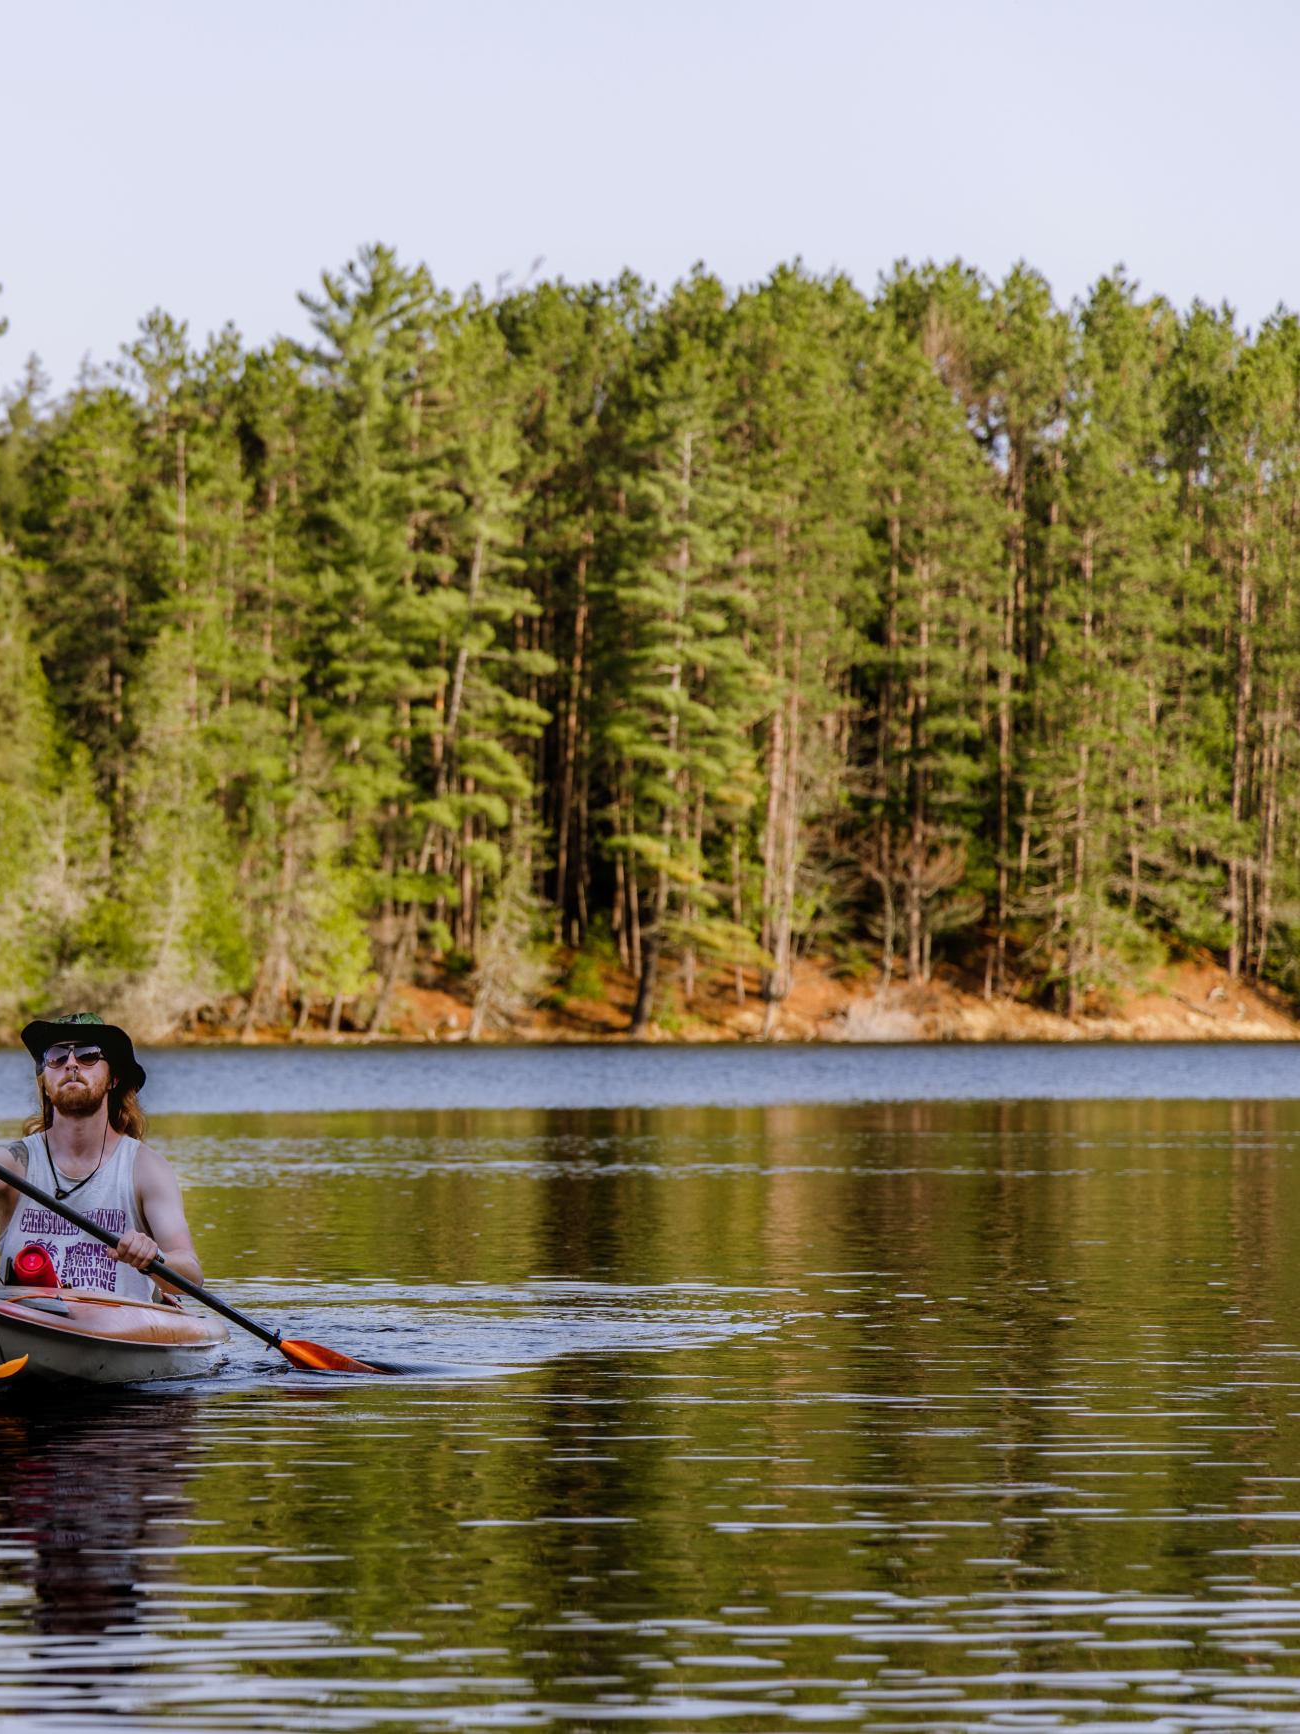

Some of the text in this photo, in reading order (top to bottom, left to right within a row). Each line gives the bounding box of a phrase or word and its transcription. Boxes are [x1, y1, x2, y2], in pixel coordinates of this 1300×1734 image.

[80, 1208, 126, 1234] AINING
[65, 1242, 108, 1257] WISCONS
[63, 1255, 117, 1271] STEVENS POINT
[61, 1267, 117, 1283] SWIMMING
[72, 1277, 116, 1292] DIVING
